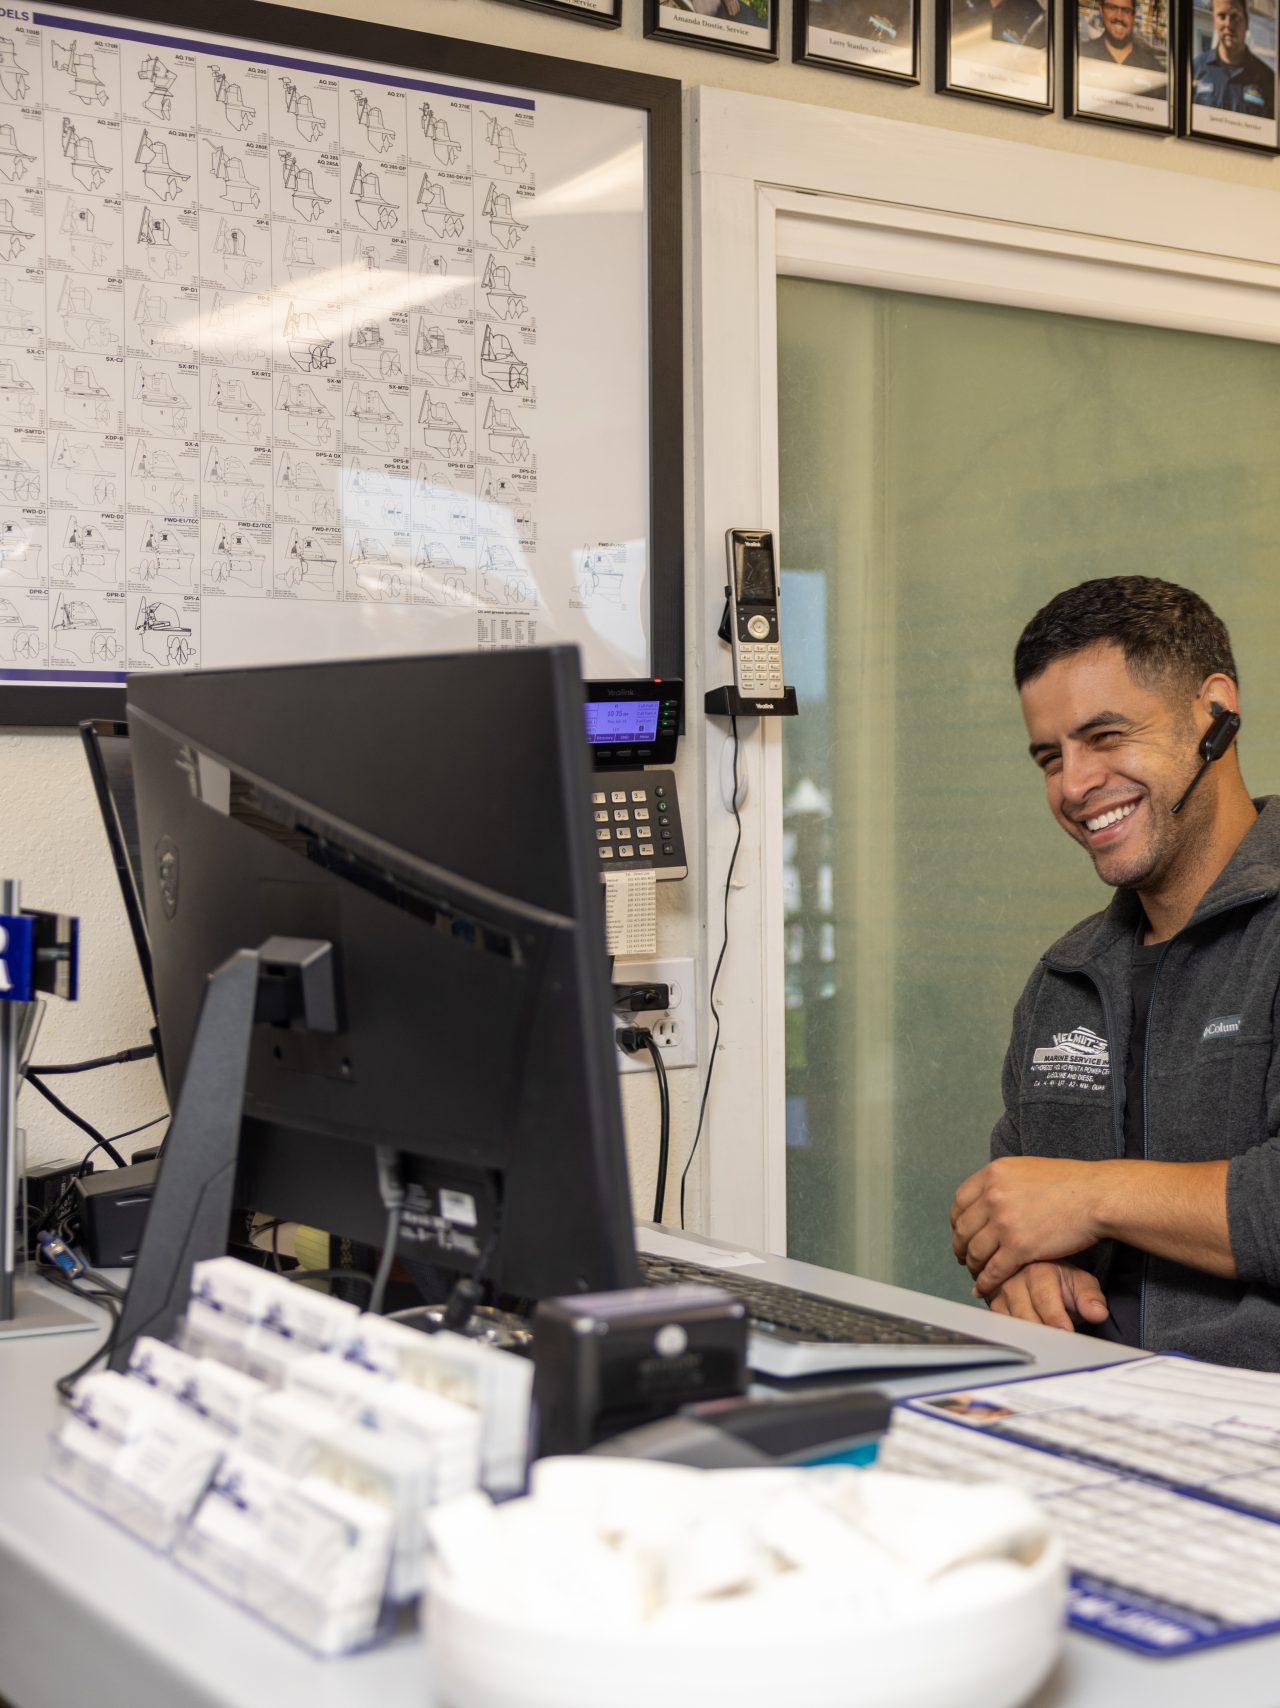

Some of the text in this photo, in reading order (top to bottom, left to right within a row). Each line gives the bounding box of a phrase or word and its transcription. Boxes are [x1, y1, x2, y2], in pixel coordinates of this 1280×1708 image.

[673, 15, 749, 36] Amanda Dostie, Service
[829, 38, 846, 49] Larry
[1209, 1020, 1241, 1034] Colum
[1053, 1032, 1108, 1051] HELMUT'S
[1070, 1056, 1101, 1065] SERVICE
[1084, 1066, 1101, 1074] POWER
